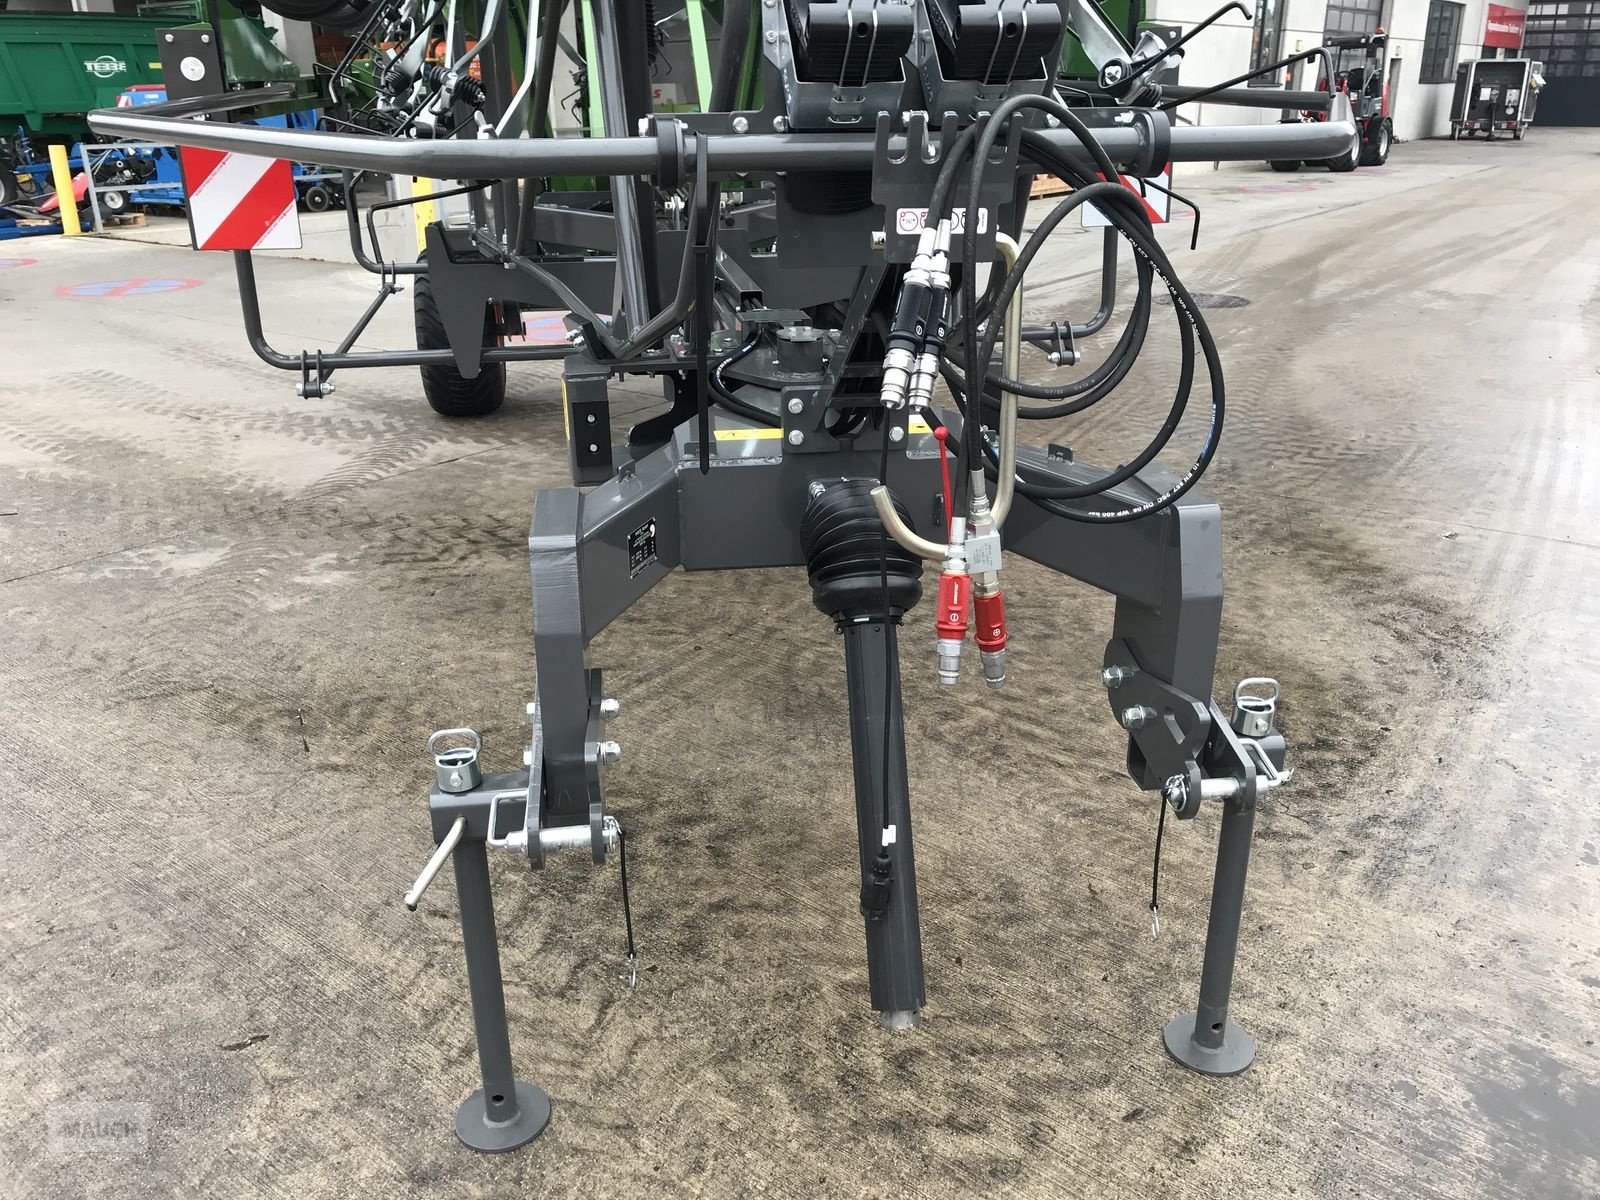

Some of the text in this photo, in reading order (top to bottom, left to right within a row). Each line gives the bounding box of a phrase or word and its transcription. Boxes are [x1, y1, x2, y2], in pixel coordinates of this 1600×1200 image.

[1183, 472, 1193, 483] EN
[1143, 502, 1154, 511] DN
[1117, 509, 1130, 517] WP
